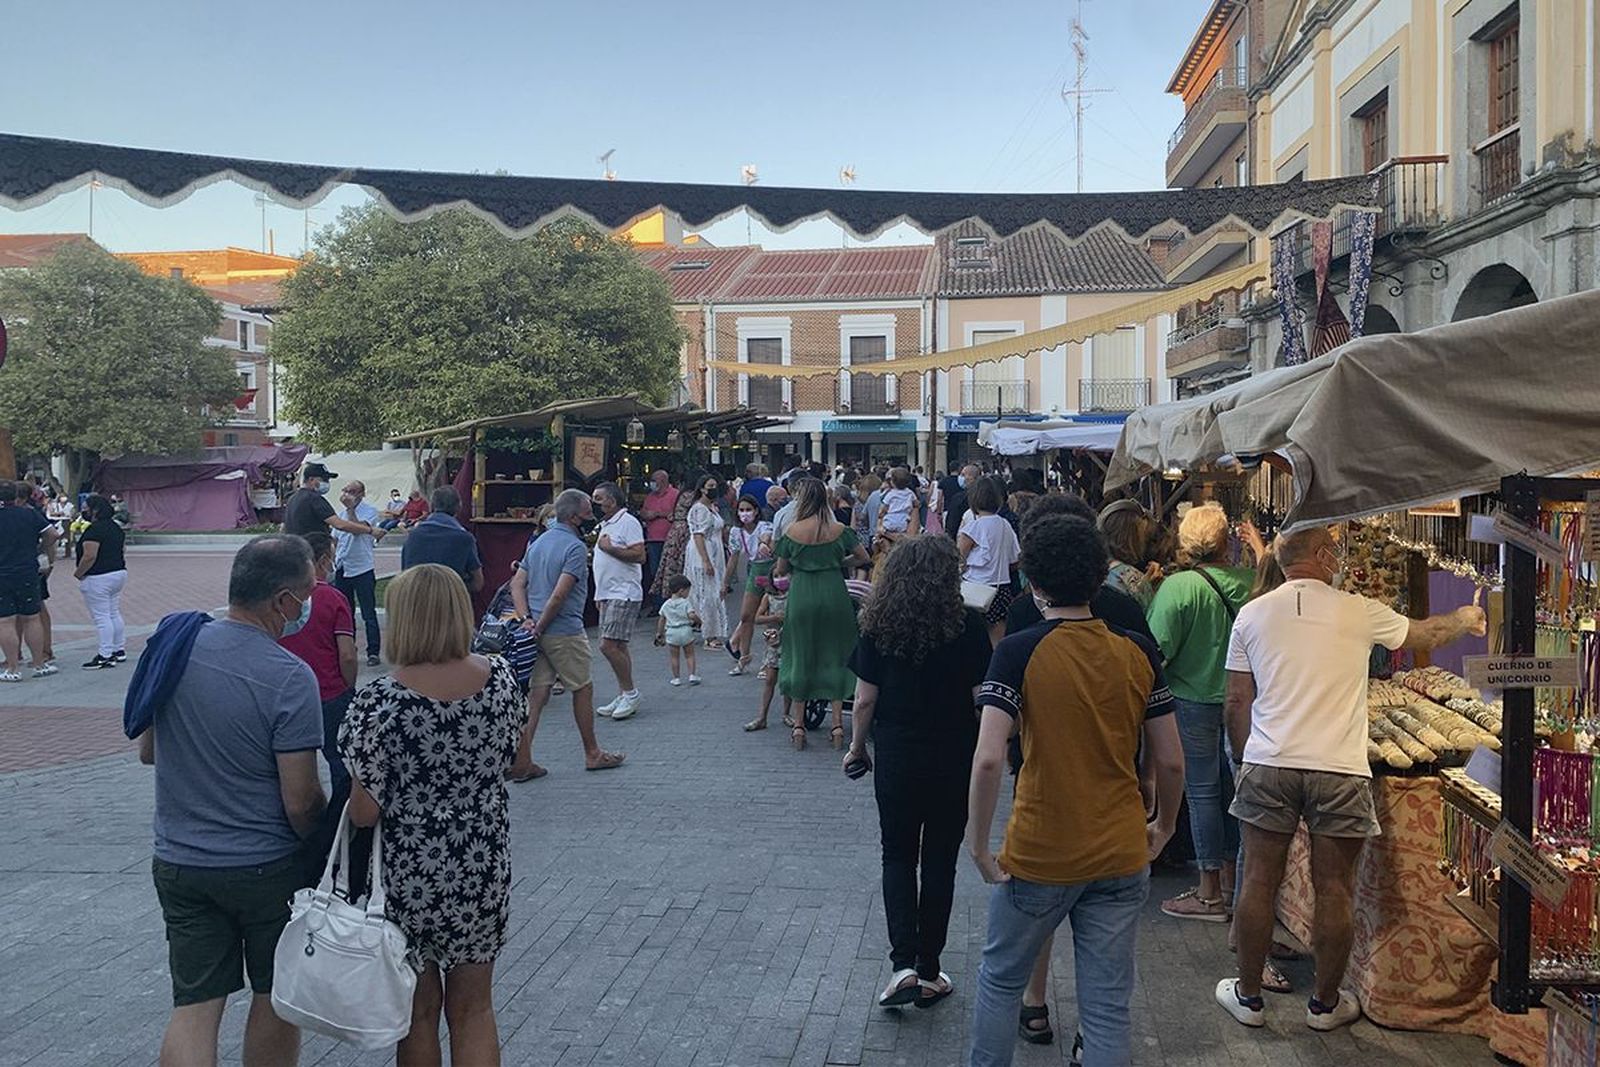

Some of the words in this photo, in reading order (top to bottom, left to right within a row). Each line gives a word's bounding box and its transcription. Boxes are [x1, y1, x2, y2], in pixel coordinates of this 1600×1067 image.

[1488, 662, 1534, 670] CUERNO
[1538, 661, 1553, 669] DE
[1488, 675, 1552, 684] UNICORNIO
